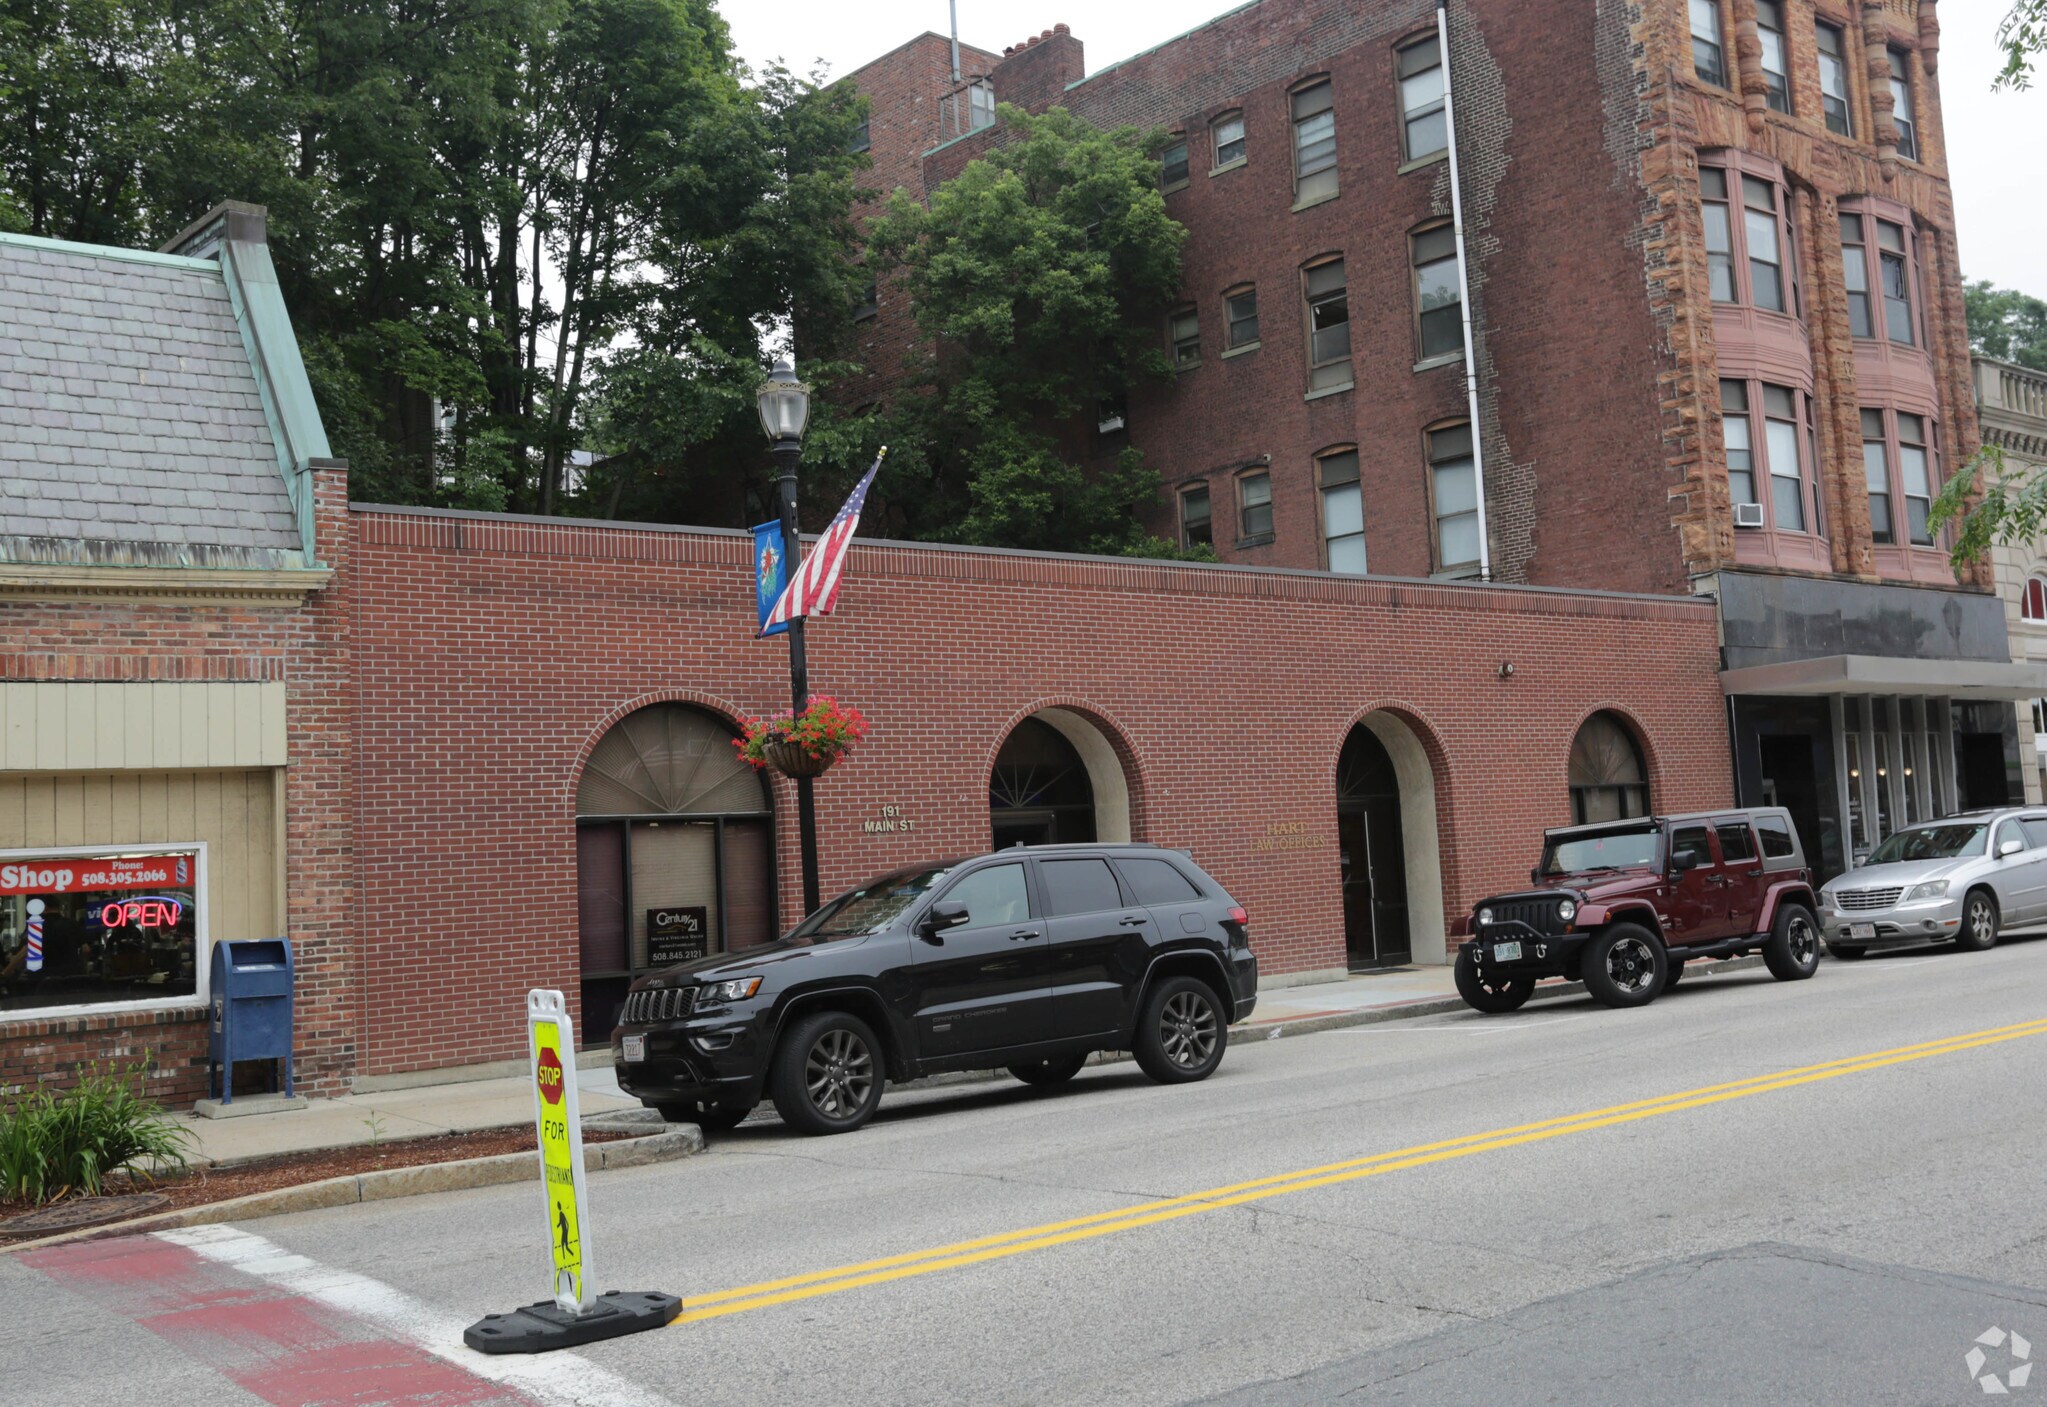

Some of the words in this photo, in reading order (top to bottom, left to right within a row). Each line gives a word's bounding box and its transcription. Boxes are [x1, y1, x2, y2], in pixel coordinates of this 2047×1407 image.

[882, 805, 899, 817] 191
[864, 820, 894, 832] MAIN
[900, 820, 914, 831] ST
[1266, 822, 1305, 835] HART
[1250, 838, 1273, 851] LAW
[1280, 836, 1325, 849] OFFICES
[112, 861, 143, 870] Phone:
[1, 865, 73, 891] Shop
[82, 869, 167, 886] 508.305.2066
[101, 903, 177, 928] OPEN
[656, 912, 691, 926] Century
[688, 918, 698, 931] 21
[652, 950, 702, 961] 508.845.2121
[539, 1065, 561, 1086] STOP
[545, 1120, 564, 1140] FOR
